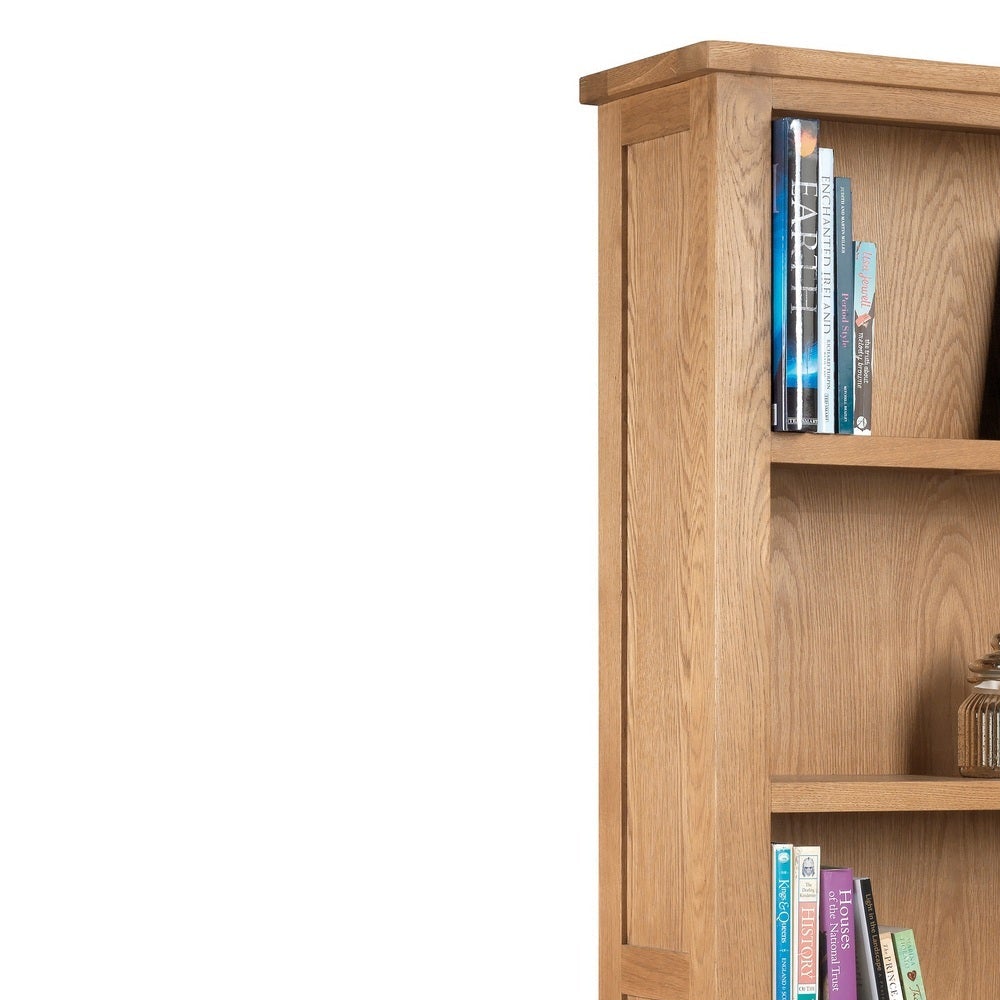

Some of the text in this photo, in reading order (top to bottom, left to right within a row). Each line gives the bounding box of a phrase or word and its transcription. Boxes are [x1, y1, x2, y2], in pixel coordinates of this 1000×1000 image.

[791, 180, 818, 313] EARTH
[821, 176, 832, 335] ENCHANTED IRELAND
[839, 293, 850, 348] Period Style
[855, 332, 867, 389] melody browne
[776, 879, 790, 944] Kings & Queens
[800, 907, 816, 980] HISTORY
[829, 891, 841, 992] of the National Trust
[839, 889, 853, 951] Houses
[864, 893, 882, 972] Light in the Landscape
[883, 955, 899, 997] PRINCE
[909, 984, 922, 1000] The
